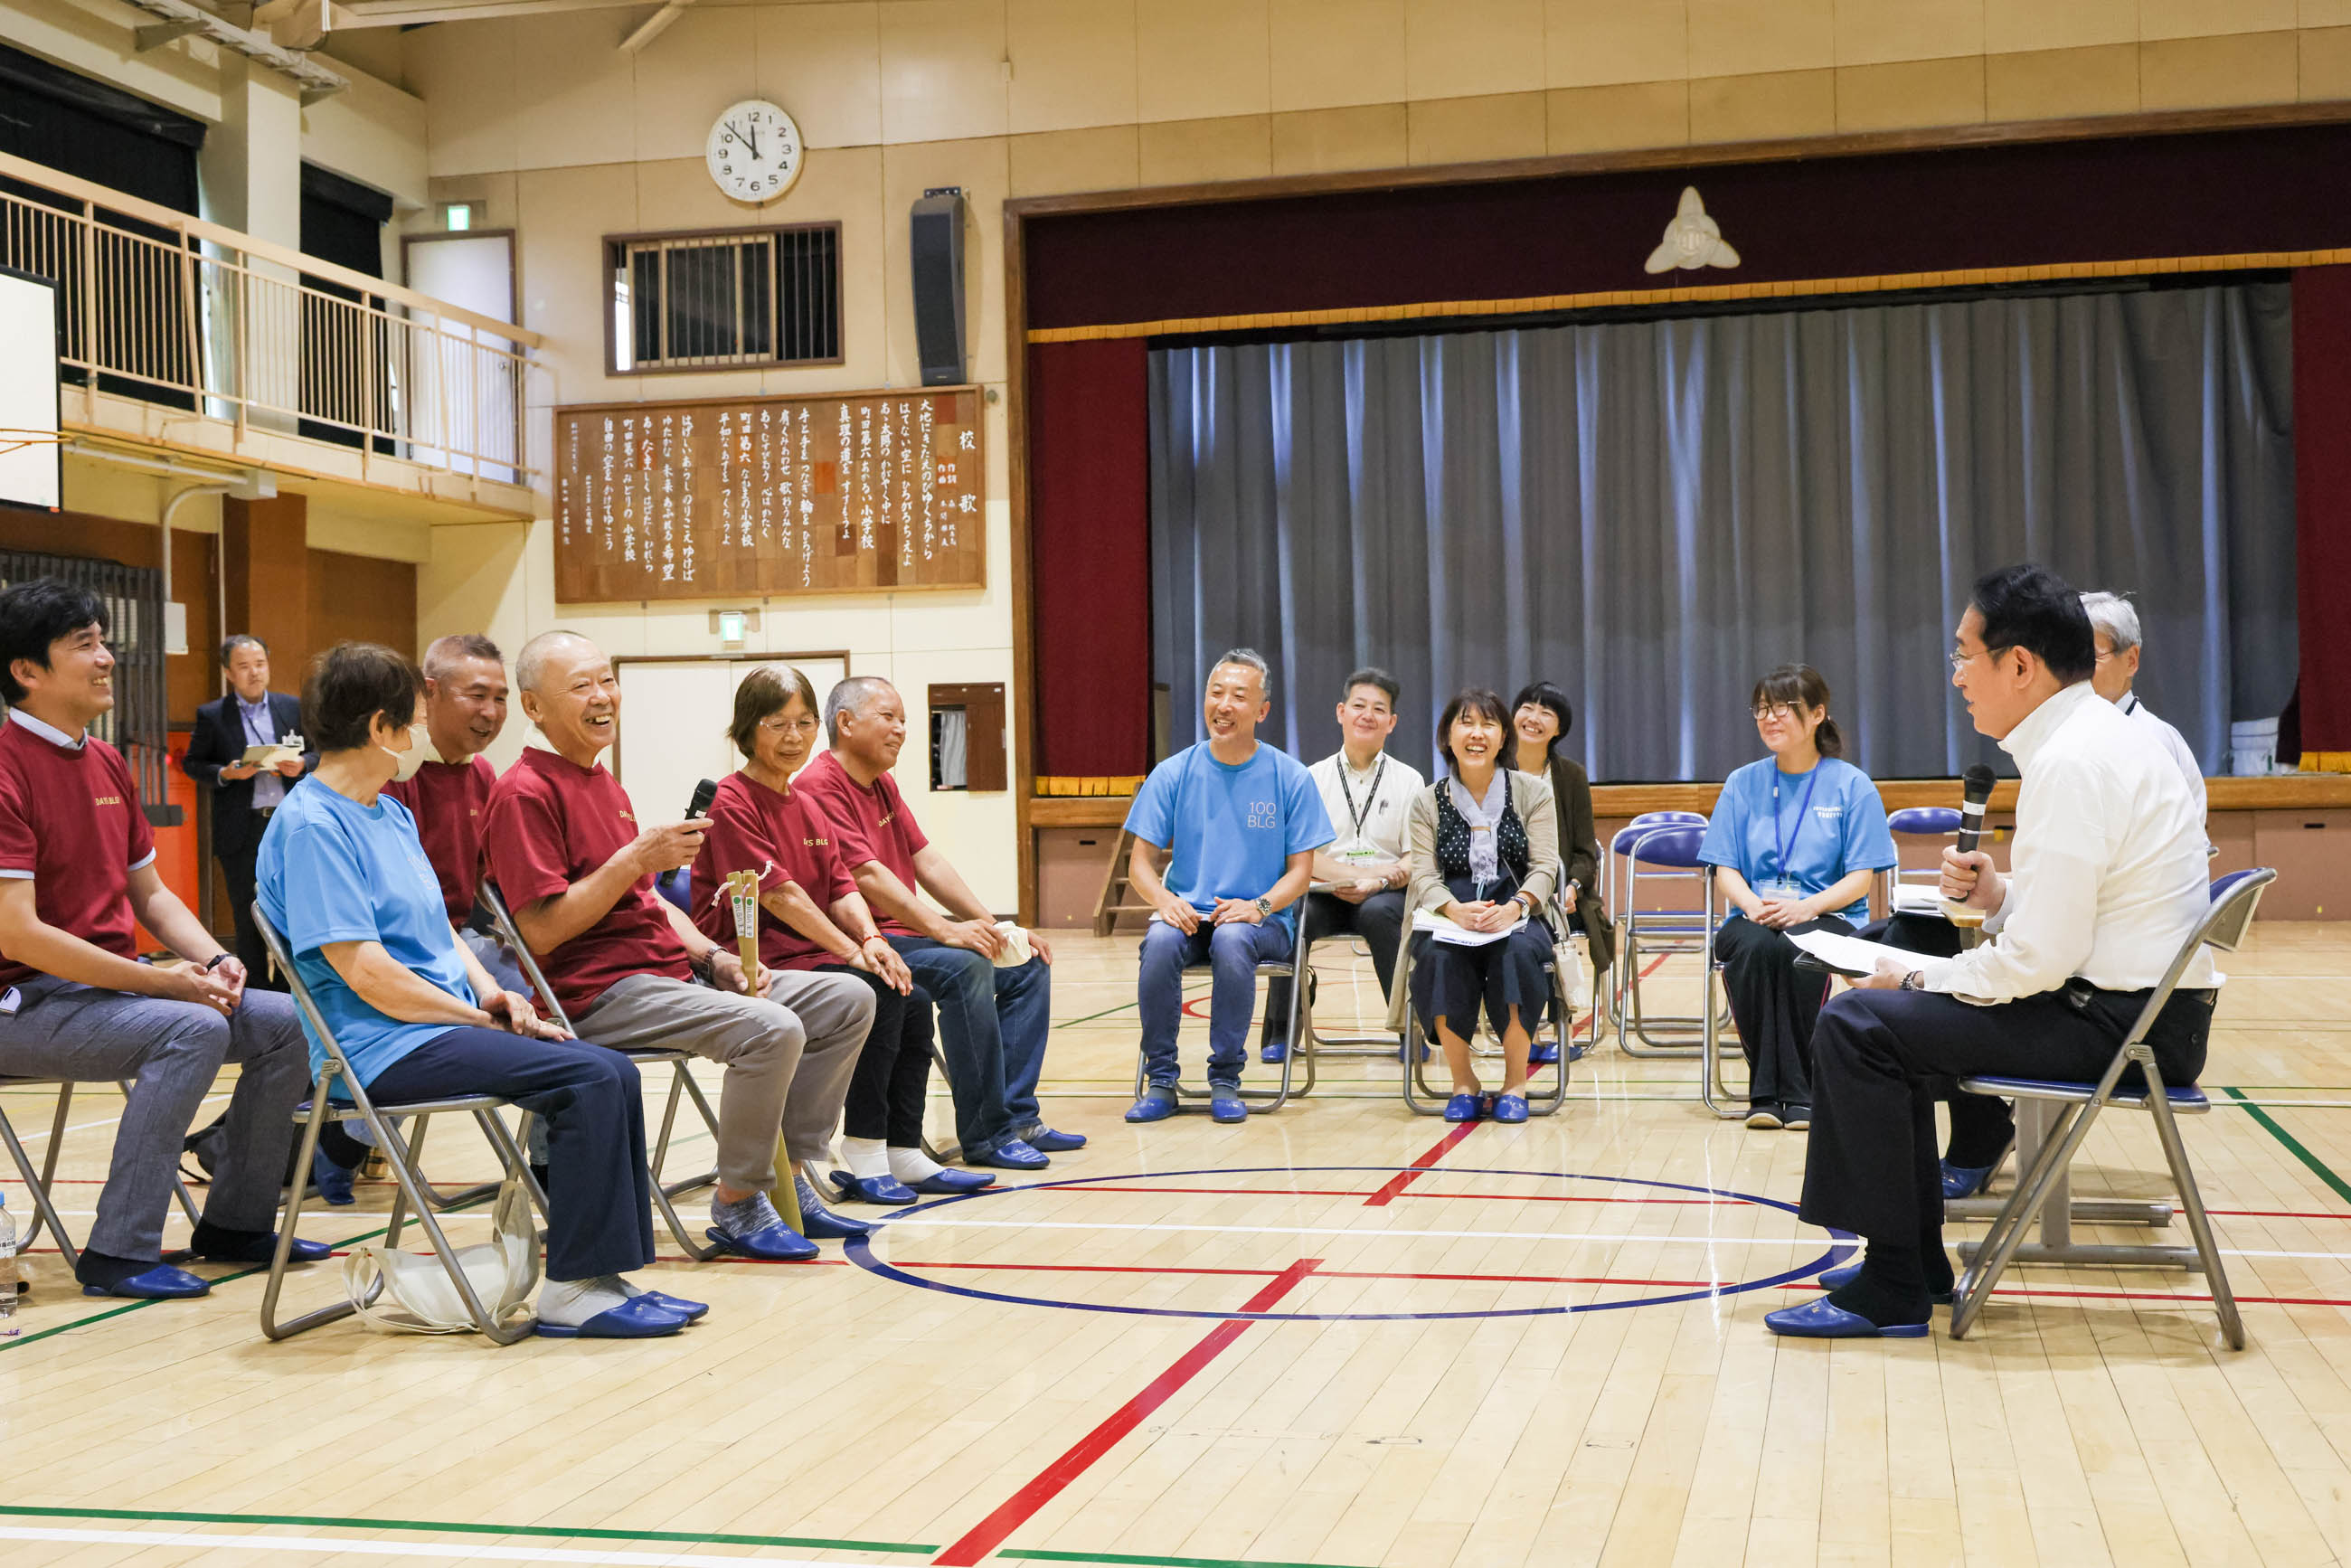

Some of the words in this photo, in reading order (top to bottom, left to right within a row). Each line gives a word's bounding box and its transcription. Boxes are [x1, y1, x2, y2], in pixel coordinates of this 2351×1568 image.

[748, 112, 760, 122] 12
[769, 116, 772, 124] 1
[779, 127, 787, 137] 2
[718, 149, 728, 159] 9
[782, 145, 791, 155] 3
[723, 165, 732, 175] 8
[779, 161, 788, 170] 4
[735, 177, 745, 188] 7
[769, 175, 779, 185] 5
[750, 181, 760, 192] 6
[958, 430, 977, 450] 校
[958, 494, 977, 514] 歌
[1249, 801, 1277, 815] 100
[1248, 815, 1276, 828] BLG
